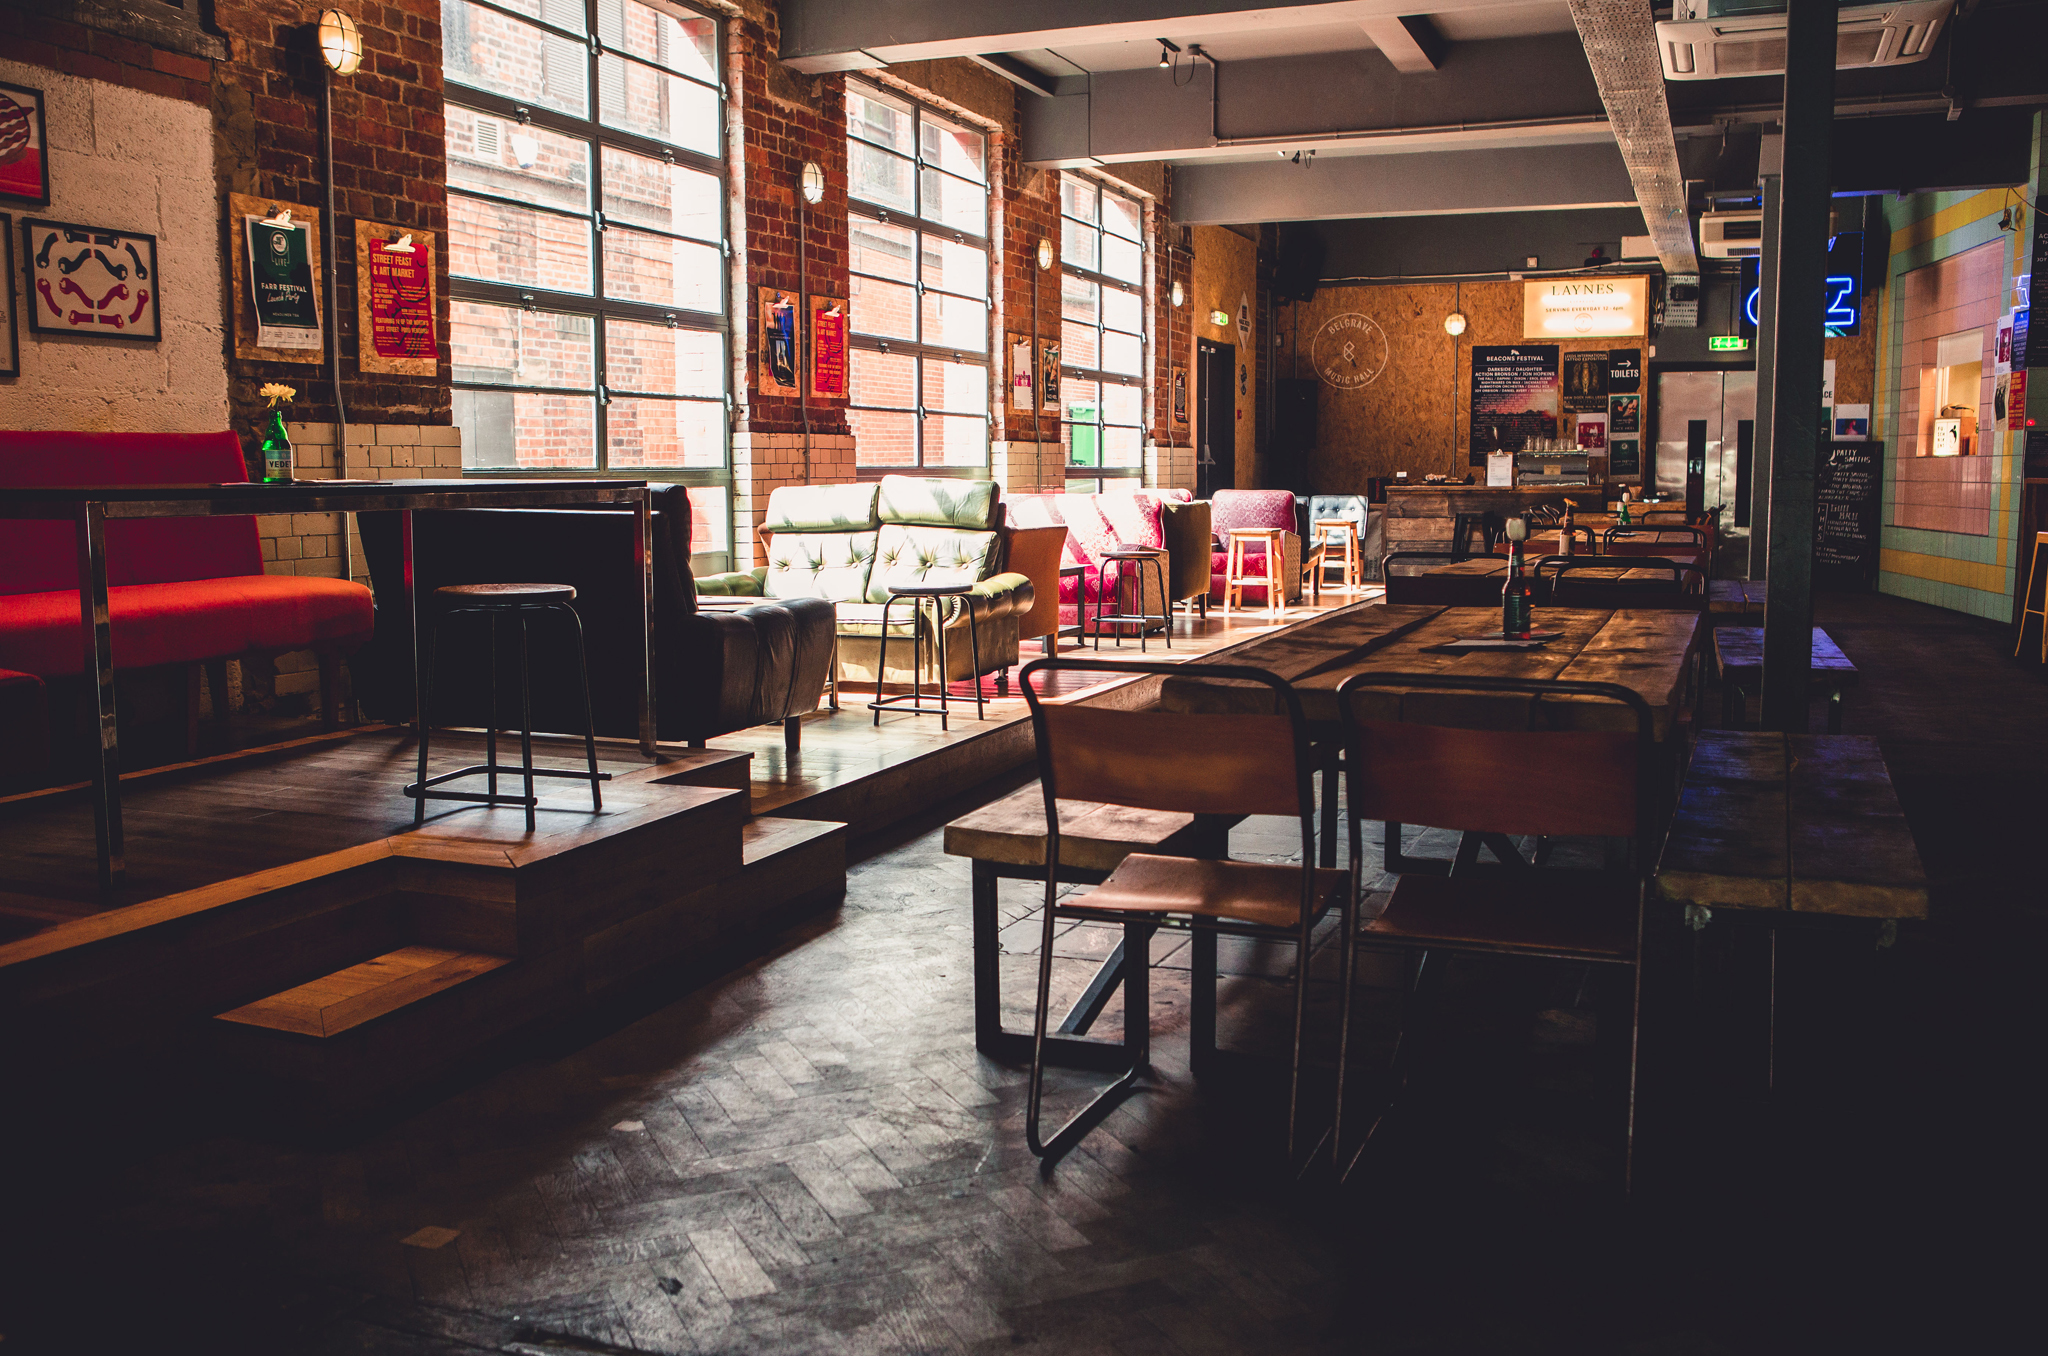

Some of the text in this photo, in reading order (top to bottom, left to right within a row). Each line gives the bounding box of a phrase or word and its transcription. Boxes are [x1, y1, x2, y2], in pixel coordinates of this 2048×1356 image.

[372, 253, 412, 266] STREET FEAST
[373, 265, 415, 278] & ART MARKET
[261, 282, 307, 293] FARR FESTIVAL
[1552, 283, 1614, 296] LAYNES
[1328, 318, 1373, 335] BELGRAVE
[1324, 367, 1375, 384] MUSIC HALL
[1610, 369, 1639, 378] TOILETS
[1844, 456, 1871, 464] SMITHS
